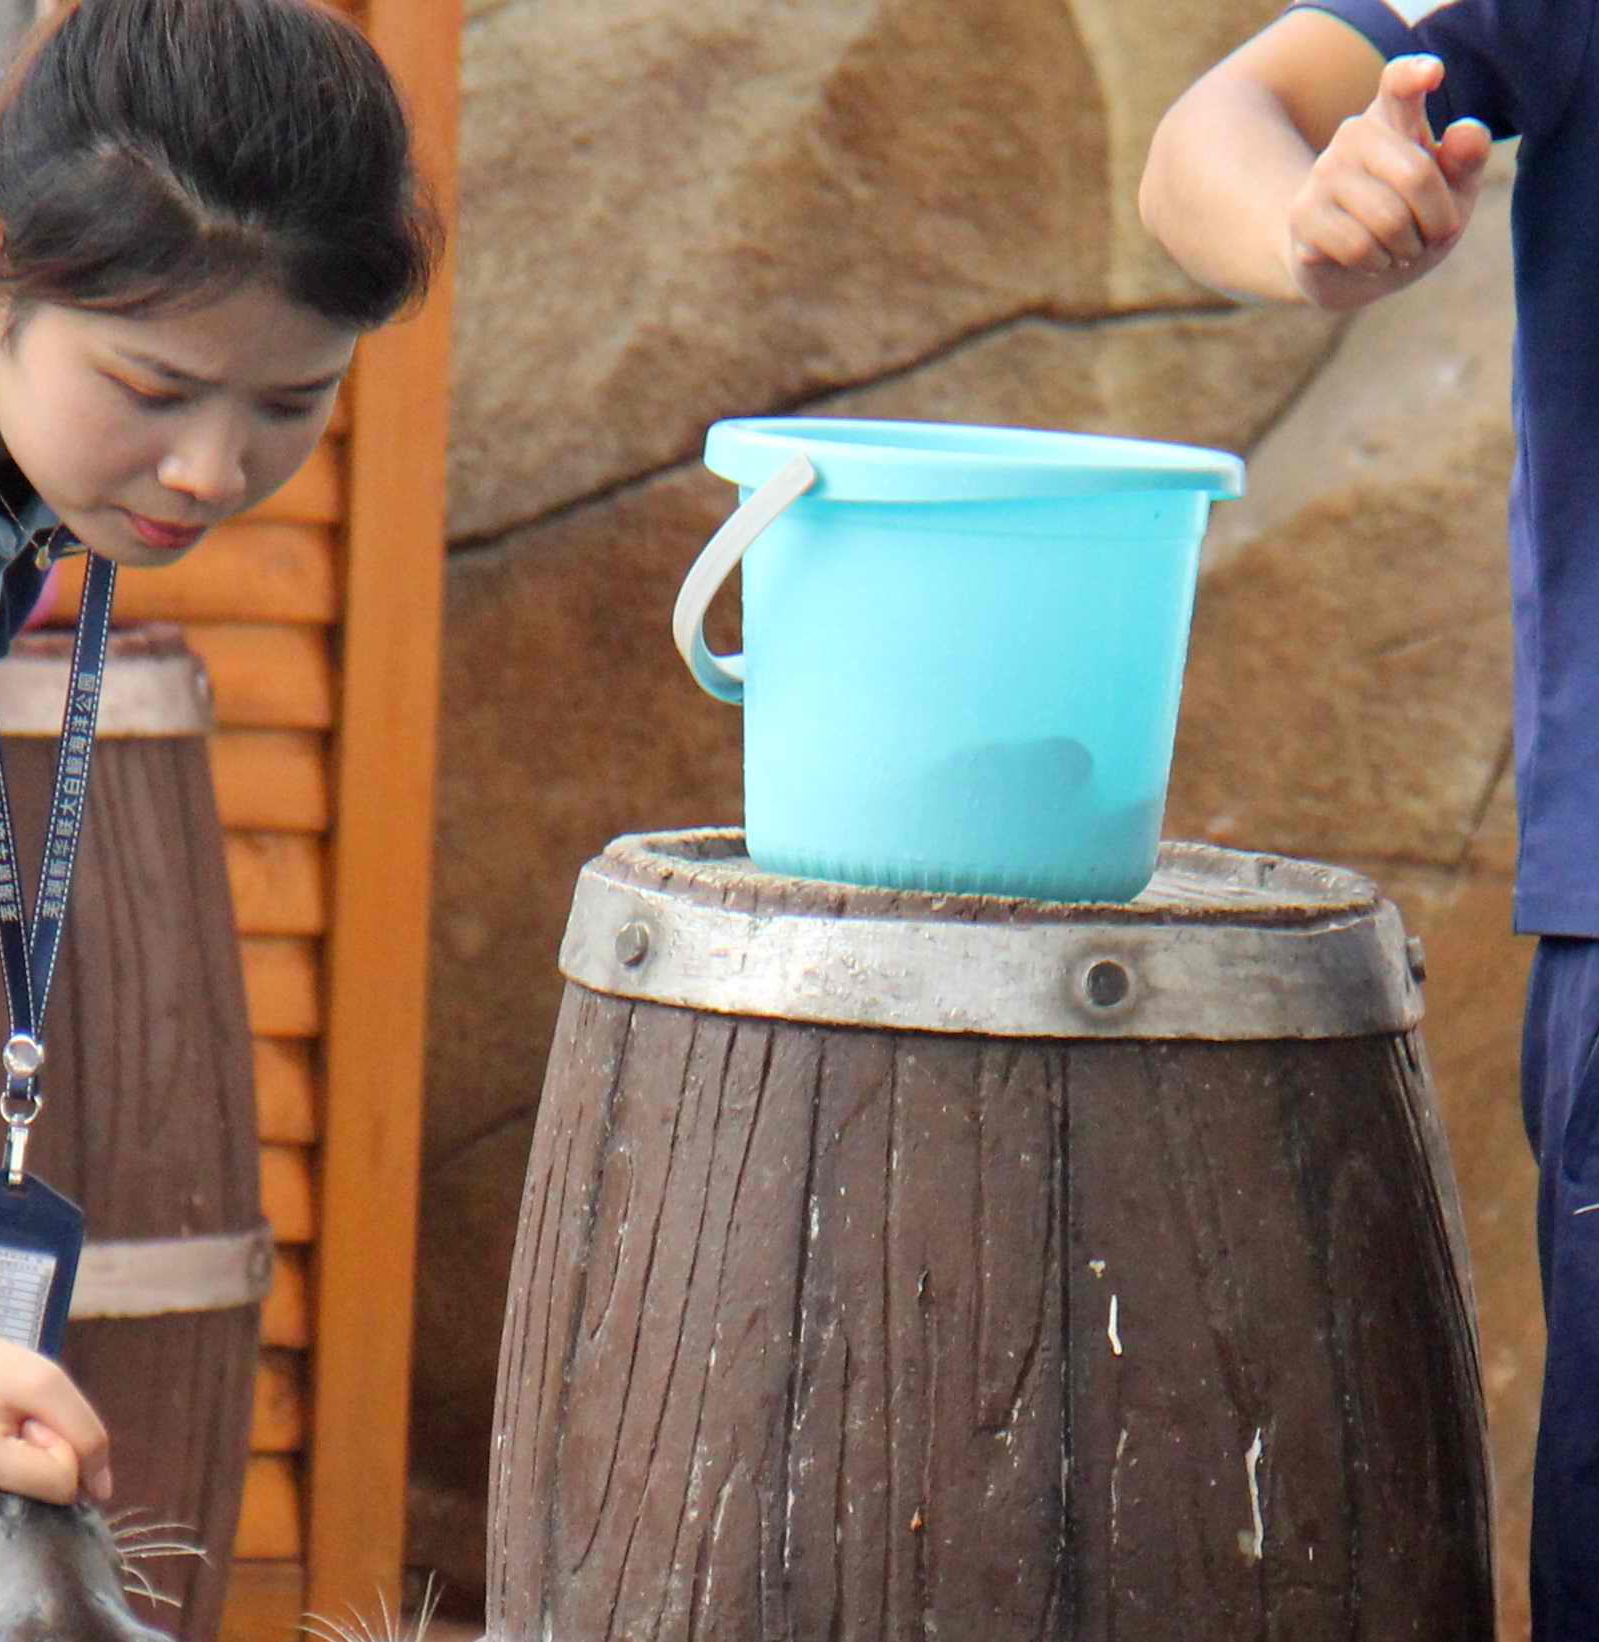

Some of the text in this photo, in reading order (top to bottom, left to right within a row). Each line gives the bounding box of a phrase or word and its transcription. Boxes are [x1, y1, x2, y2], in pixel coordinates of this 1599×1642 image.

[41, 671, 97, 920] 芜湖新华联大白鲸海洋公园
